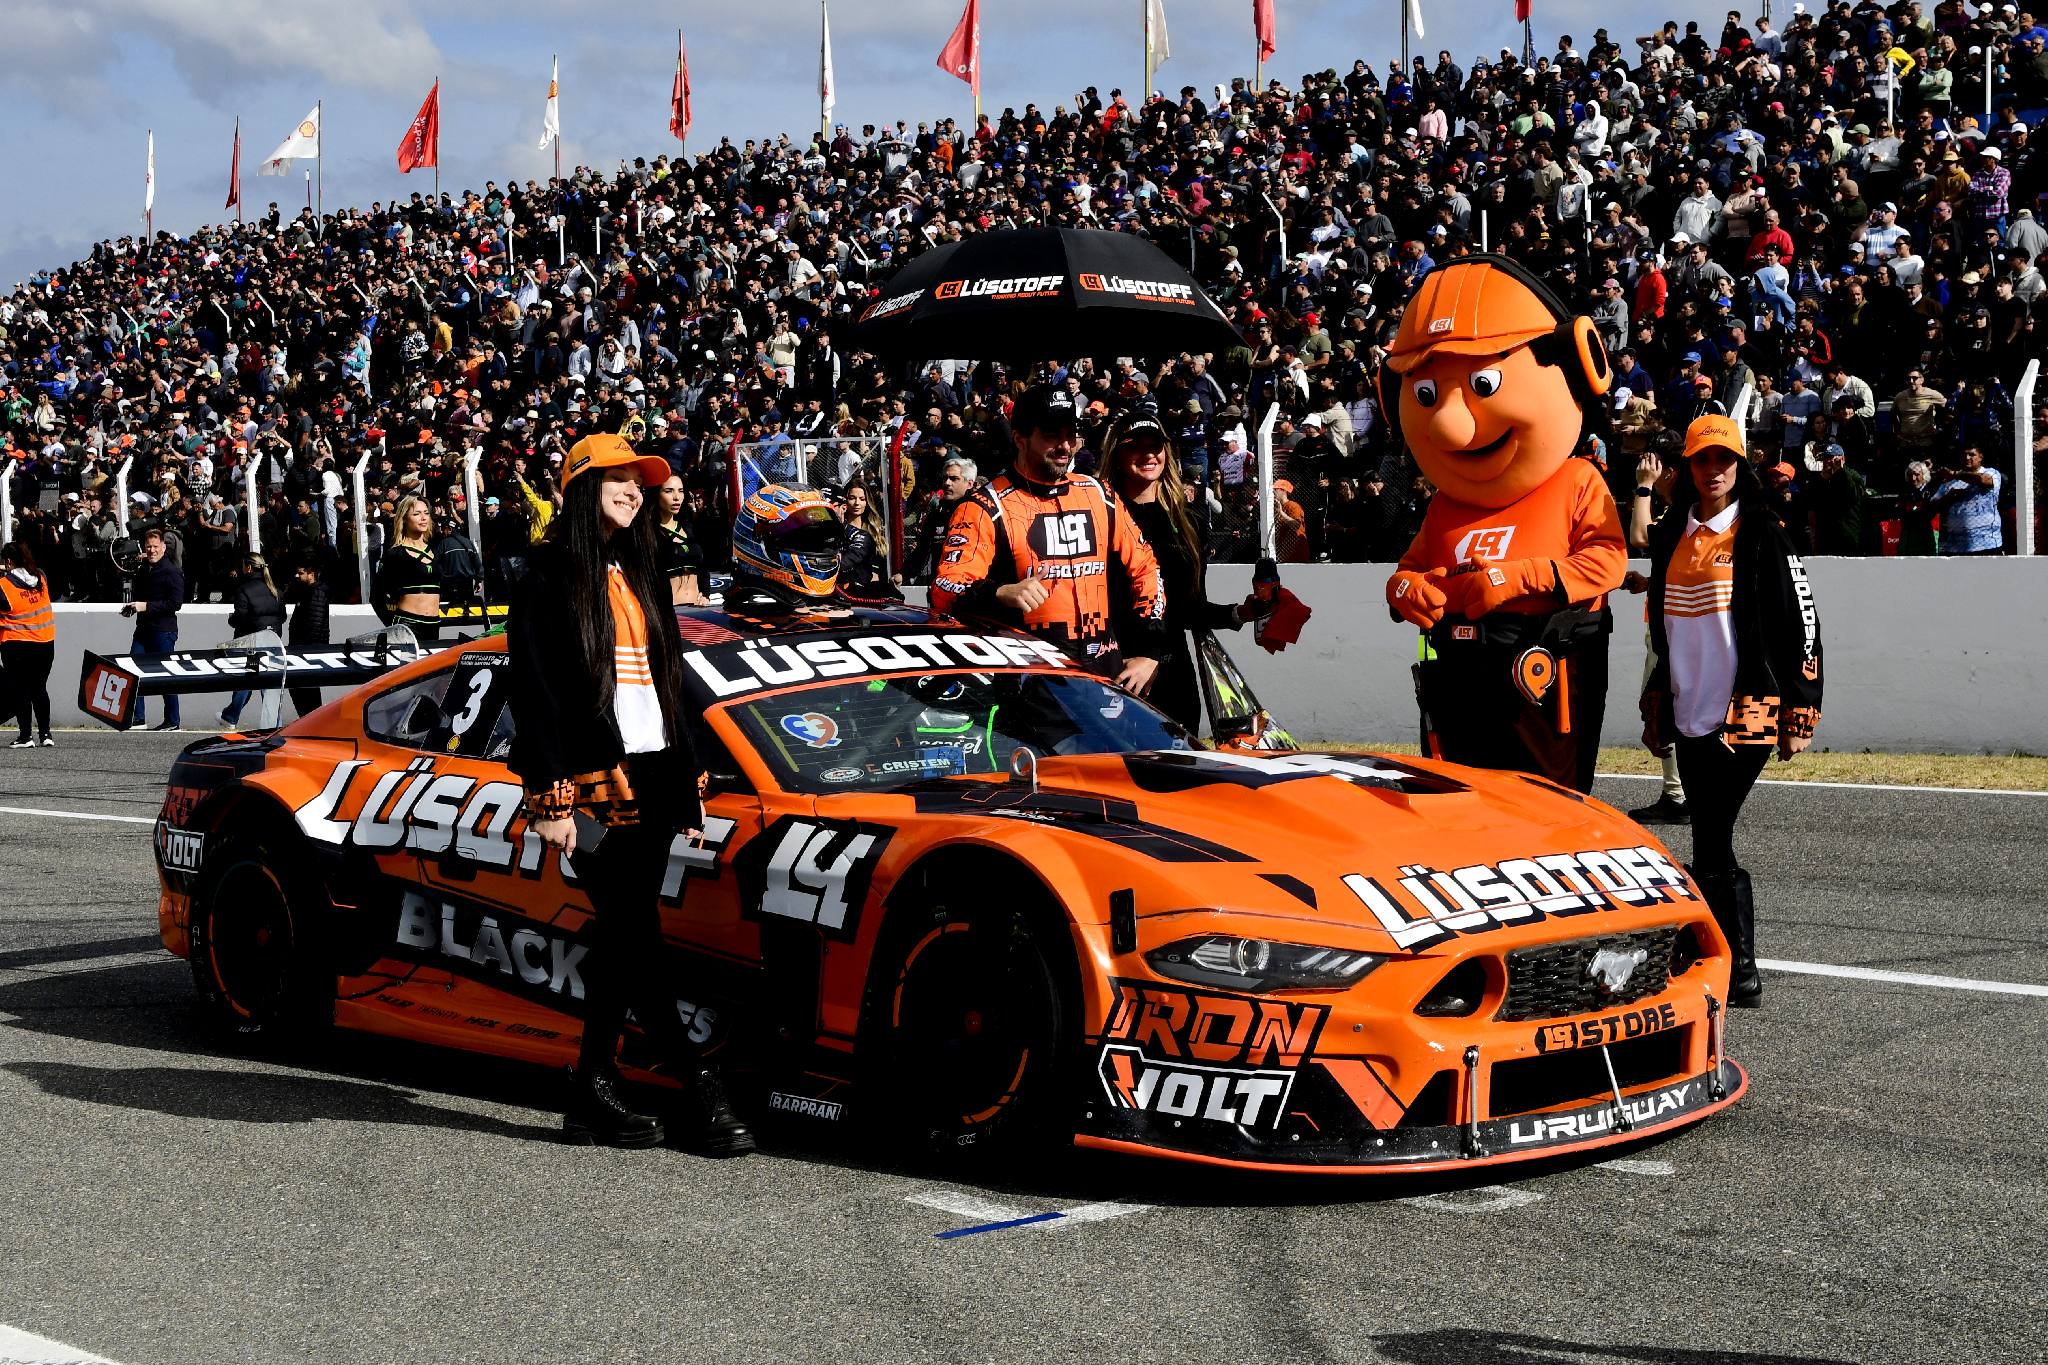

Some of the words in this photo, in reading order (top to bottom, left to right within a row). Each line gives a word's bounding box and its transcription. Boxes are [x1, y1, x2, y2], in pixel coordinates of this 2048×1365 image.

[452, 668, 493, 735] 3
[681, 634, 1073, 698] LÜSQTOFF
[761, 821, 876, 930] 14
[1342, 846, 1694, 950] LÜSQTOFF
[397, 892, 589, 1001] BLACK
[1108, 986, 1323, 1067] IRON
[1578, 1003, 1676, 1047] STORE
[1111, 1054, 1284, 1126] VOLT
[1509, 1084, 1692, 1144] URUGUAY
